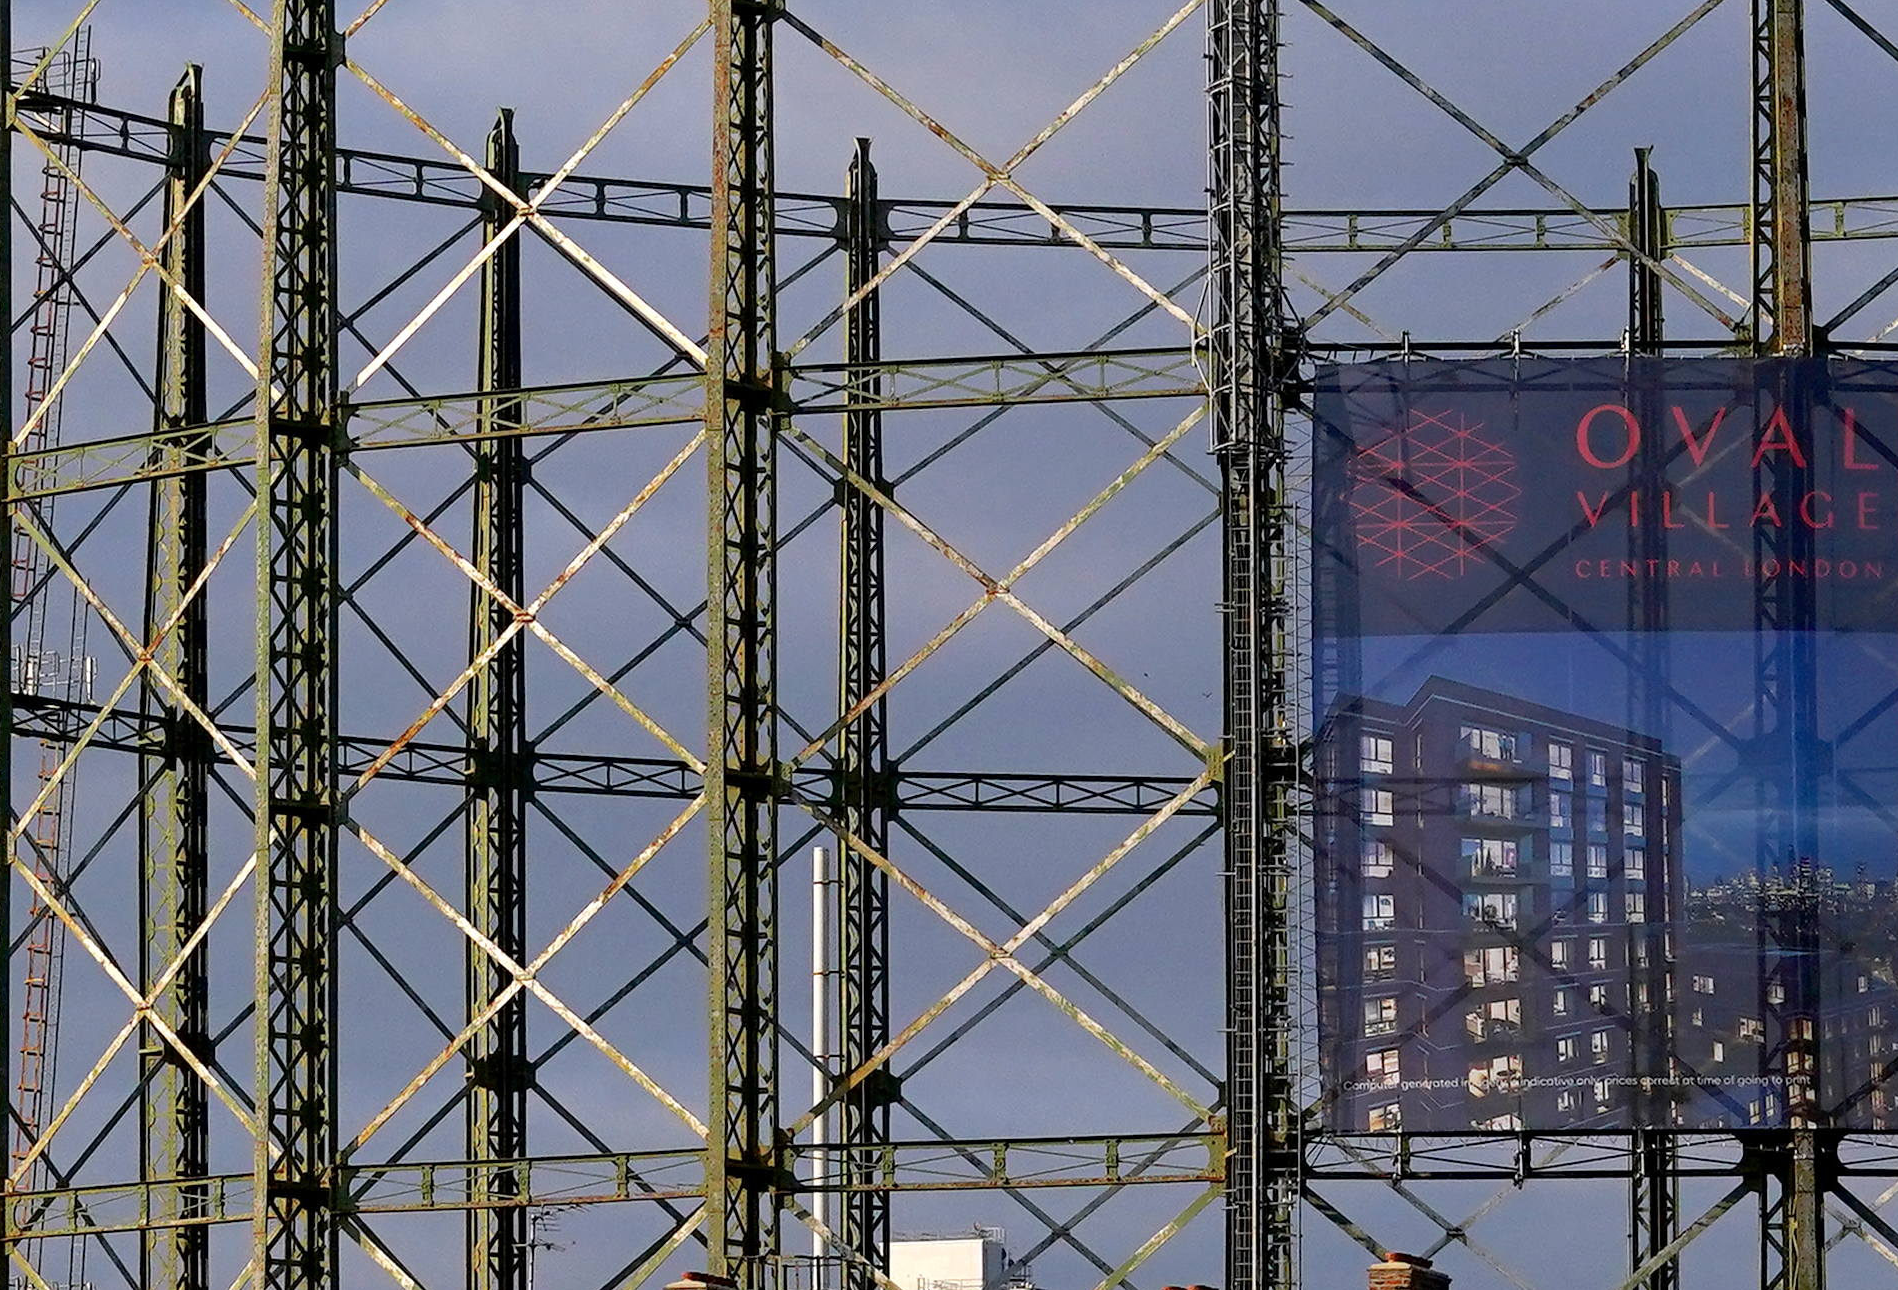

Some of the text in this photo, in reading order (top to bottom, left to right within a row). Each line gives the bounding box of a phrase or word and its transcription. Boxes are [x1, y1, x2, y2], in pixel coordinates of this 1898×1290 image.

[1576, 403, 1880, 471] OVAL
[1576, 490, 1881, 530] VILLAGE
[1575, 559, 1883, 581] CENTRAL LONDON
[1343, 1077, 1398, 1092] Computer
[1401, 1076, 1459, 1091] generated
[1520, 1076, 1574, 1089] indicative
[1606, 1074, 1638, 1089] prices
[1640, 1074, 1680, 1087] correct
[1683, 1075, 1695, 1086] at
[1697, 1073, 1721, 1087] time
[1723, 1074, 1735, 1086] of
[1737, 1075, 1769, 1089] going
[1771, 1075, 1783, 1087] to
[1785, 1074, 1812, 1089] print
